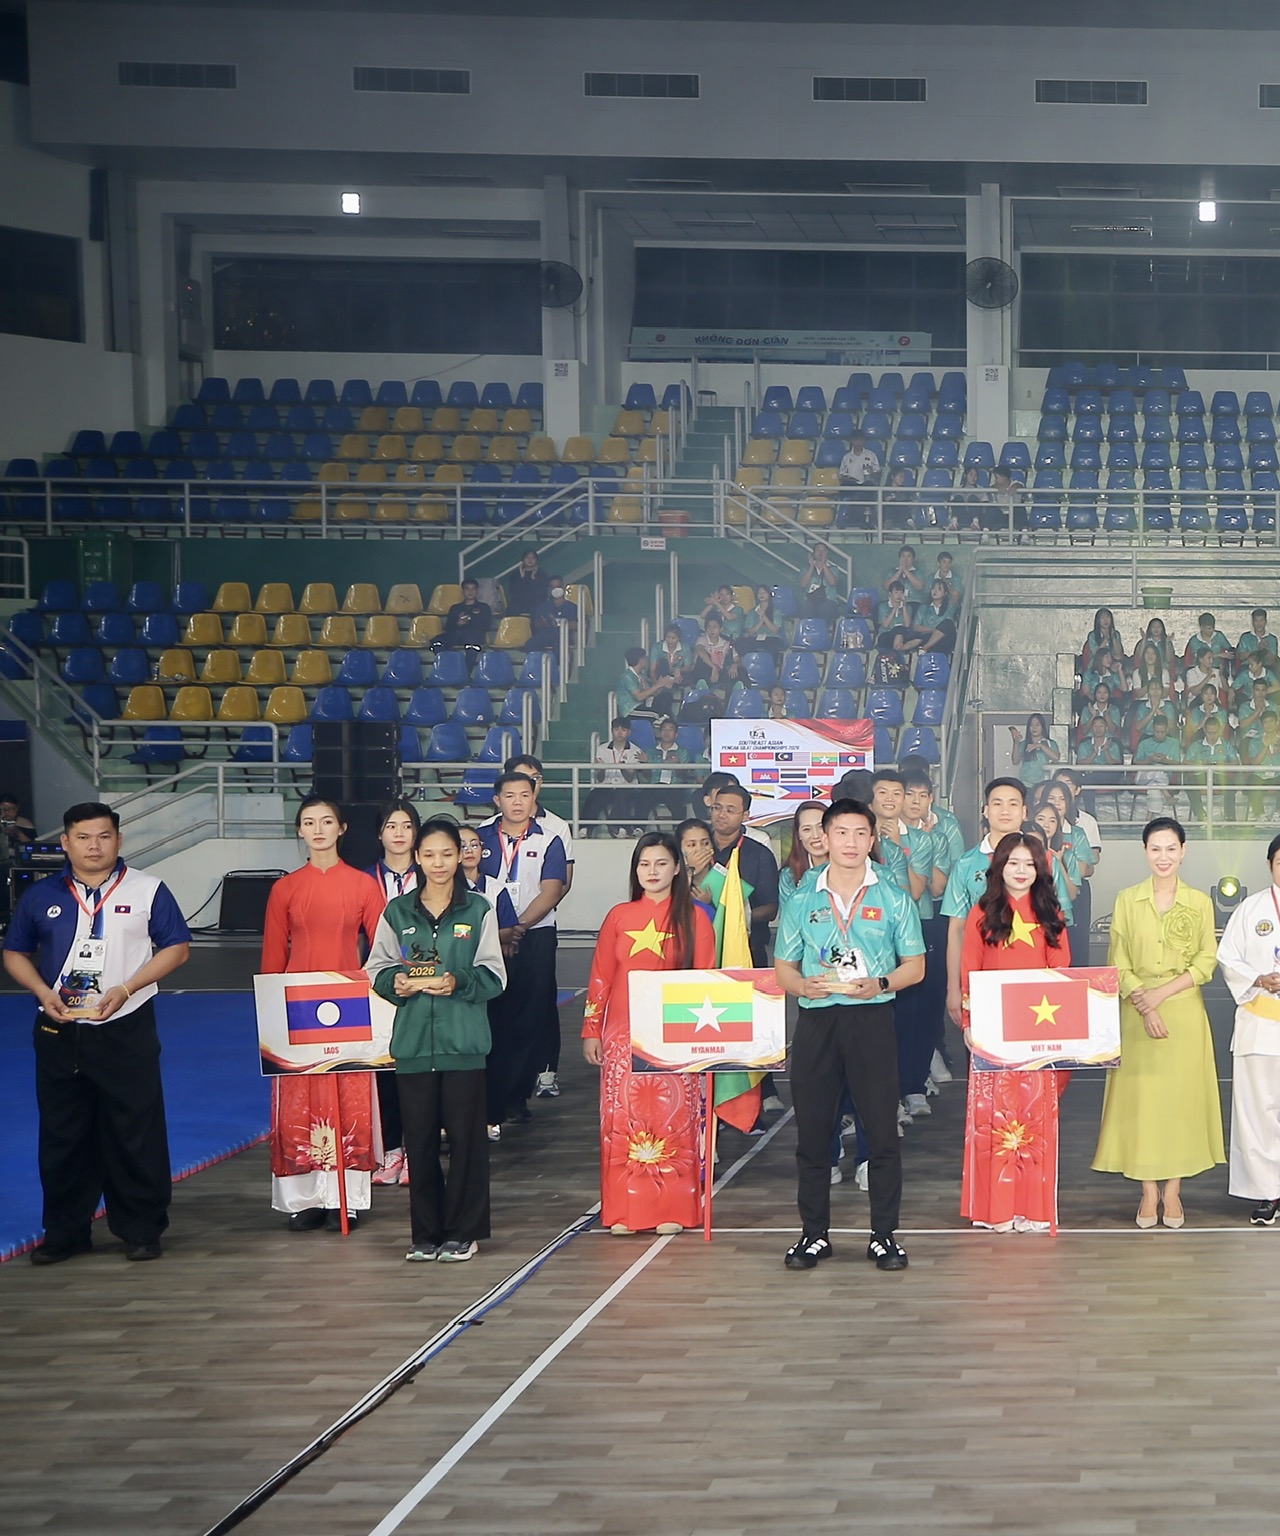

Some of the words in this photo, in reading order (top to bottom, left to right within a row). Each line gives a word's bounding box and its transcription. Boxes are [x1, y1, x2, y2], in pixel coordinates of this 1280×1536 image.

[409, 966, 436, 977] 2026
[323, 1046, 340, 1055] LAOS
[691, 1046, 725, 1054] MYANMAR
[1030, 1044, 1045, 1053] VIET
[1047, 1044, 1062, 1052] NAM
